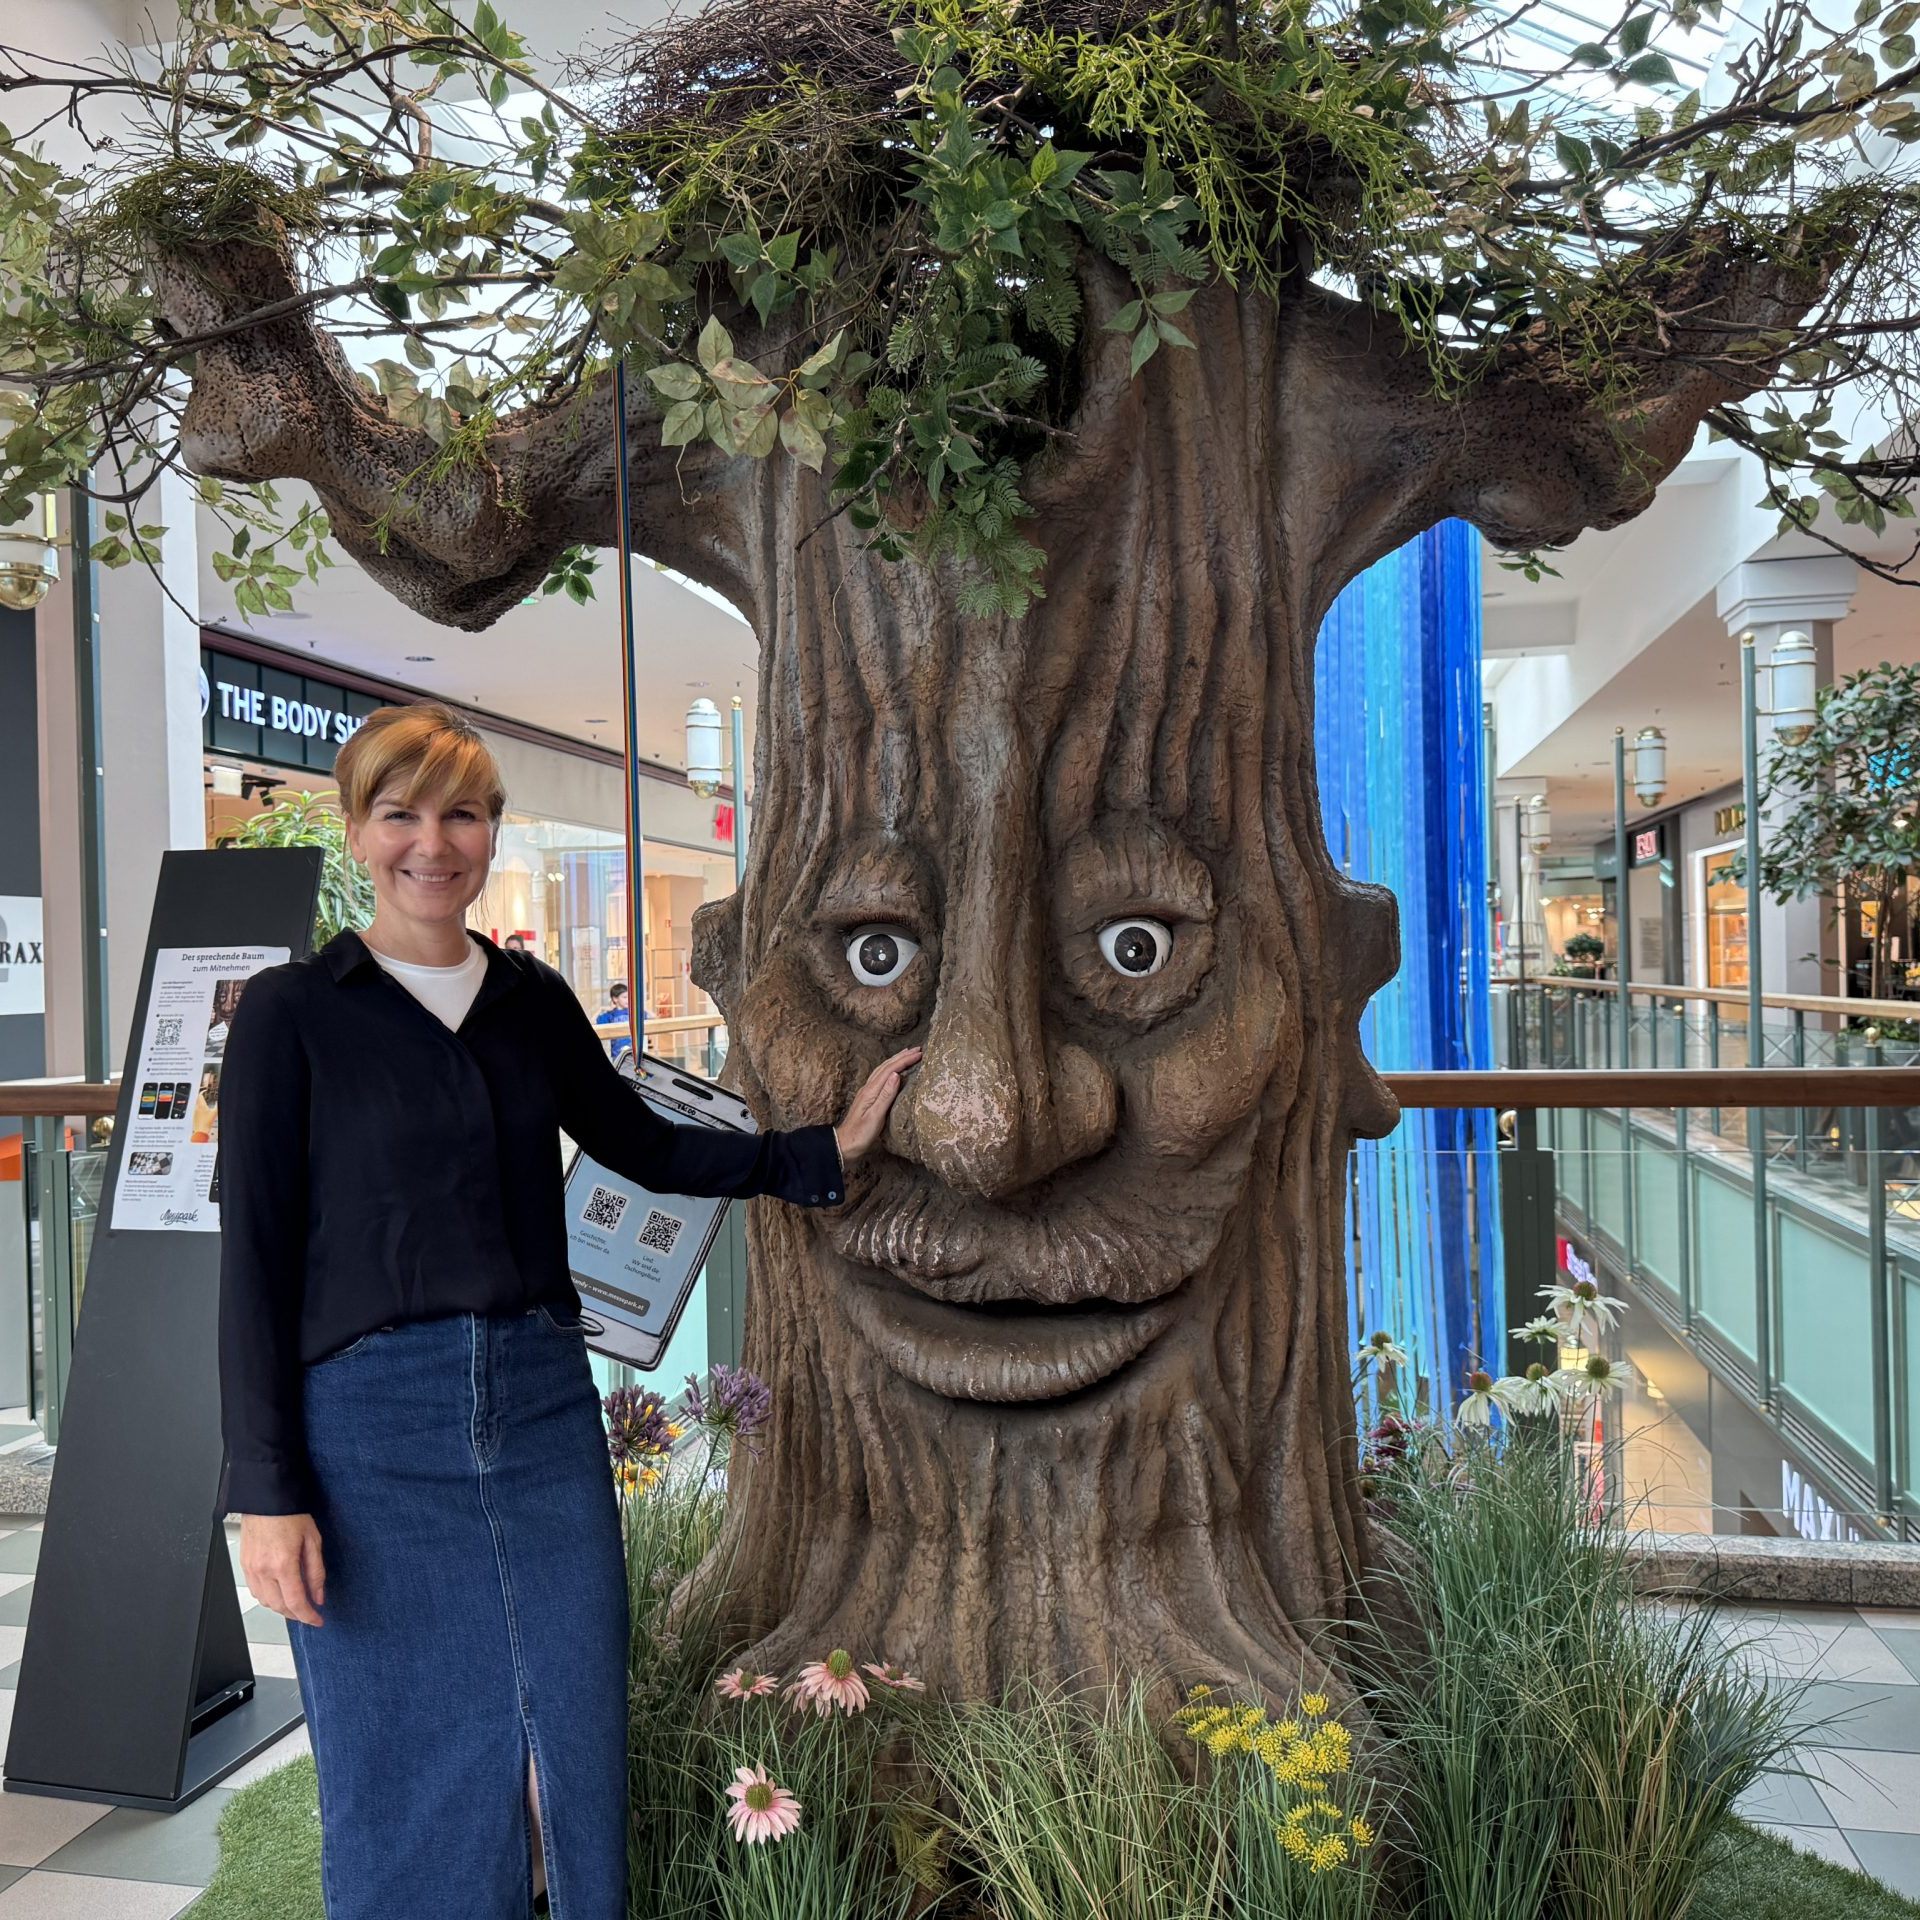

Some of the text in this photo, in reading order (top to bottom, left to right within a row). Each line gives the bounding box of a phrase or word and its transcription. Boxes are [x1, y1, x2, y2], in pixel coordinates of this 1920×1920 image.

[216, 681, 368, 745] THE BODY SH
[182, 952, 265, 963] Der sprechende Baum
[209, 964, 250, 972] Mitnehmen
[592, 1286, 644, 1310] www.messepark.at
